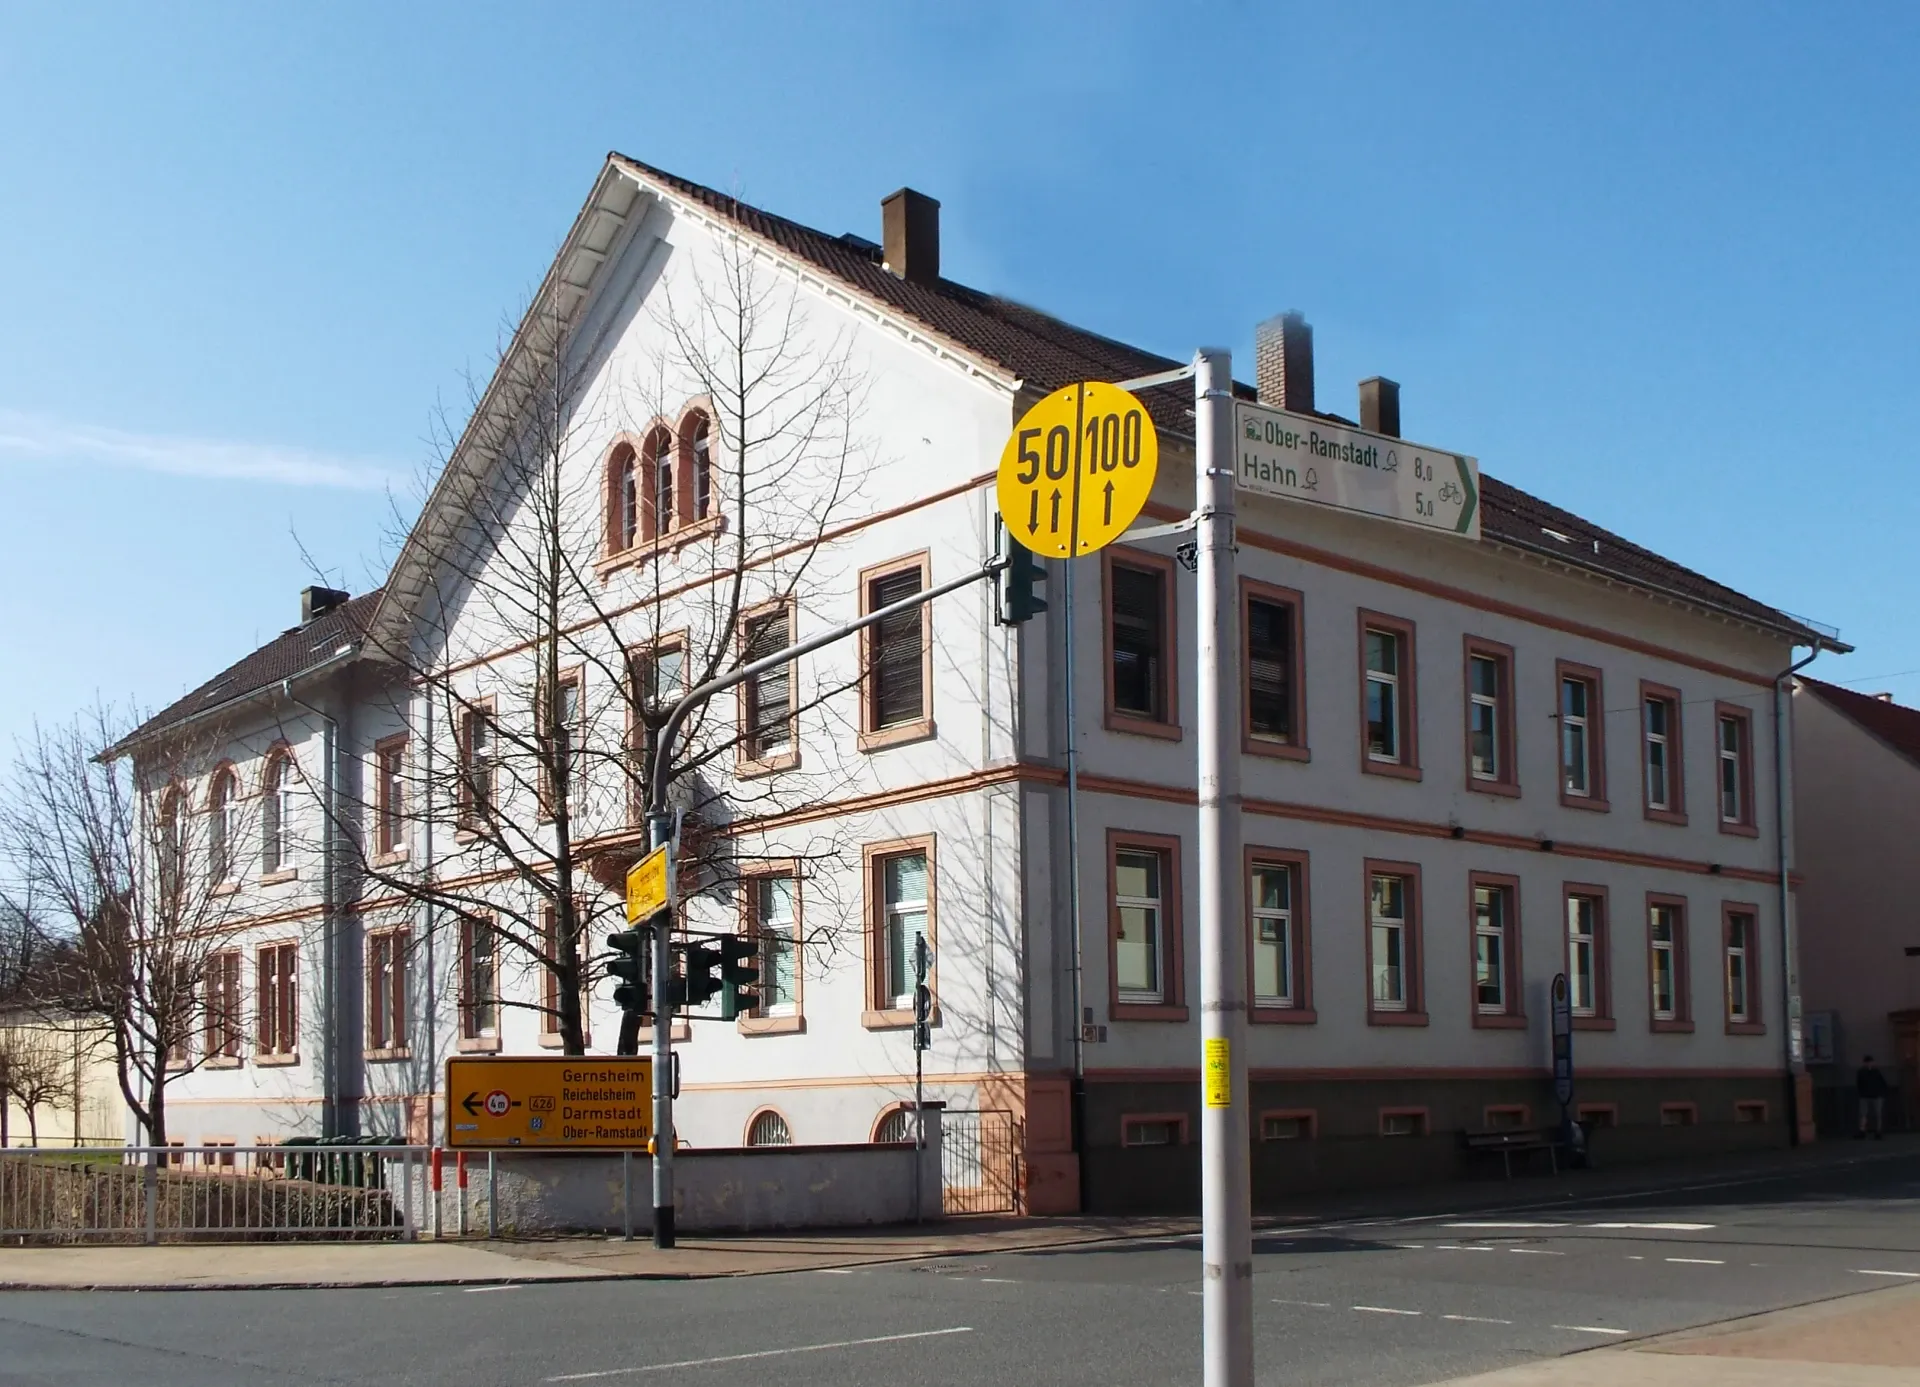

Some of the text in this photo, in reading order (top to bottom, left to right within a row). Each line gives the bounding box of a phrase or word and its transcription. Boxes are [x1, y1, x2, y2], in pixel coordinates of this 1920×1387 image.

[1085, 409, 1142, 475] 100
[1265, 420, 1379, 470] Ober-Ramstadt
[1017, 425, 1070, 485] 50
[1244, 454, 1297, 488] Hahn
[563, 1069, 645, 1083] Gernsheim
[563, 1087, 636, 1102] Reichelsheim
[532, 1098, 553, 1110] 426
[563, 1106, 642, 1120] Darmstadt
[563, 1125, 648, 1139] Ober-Ramstadt
